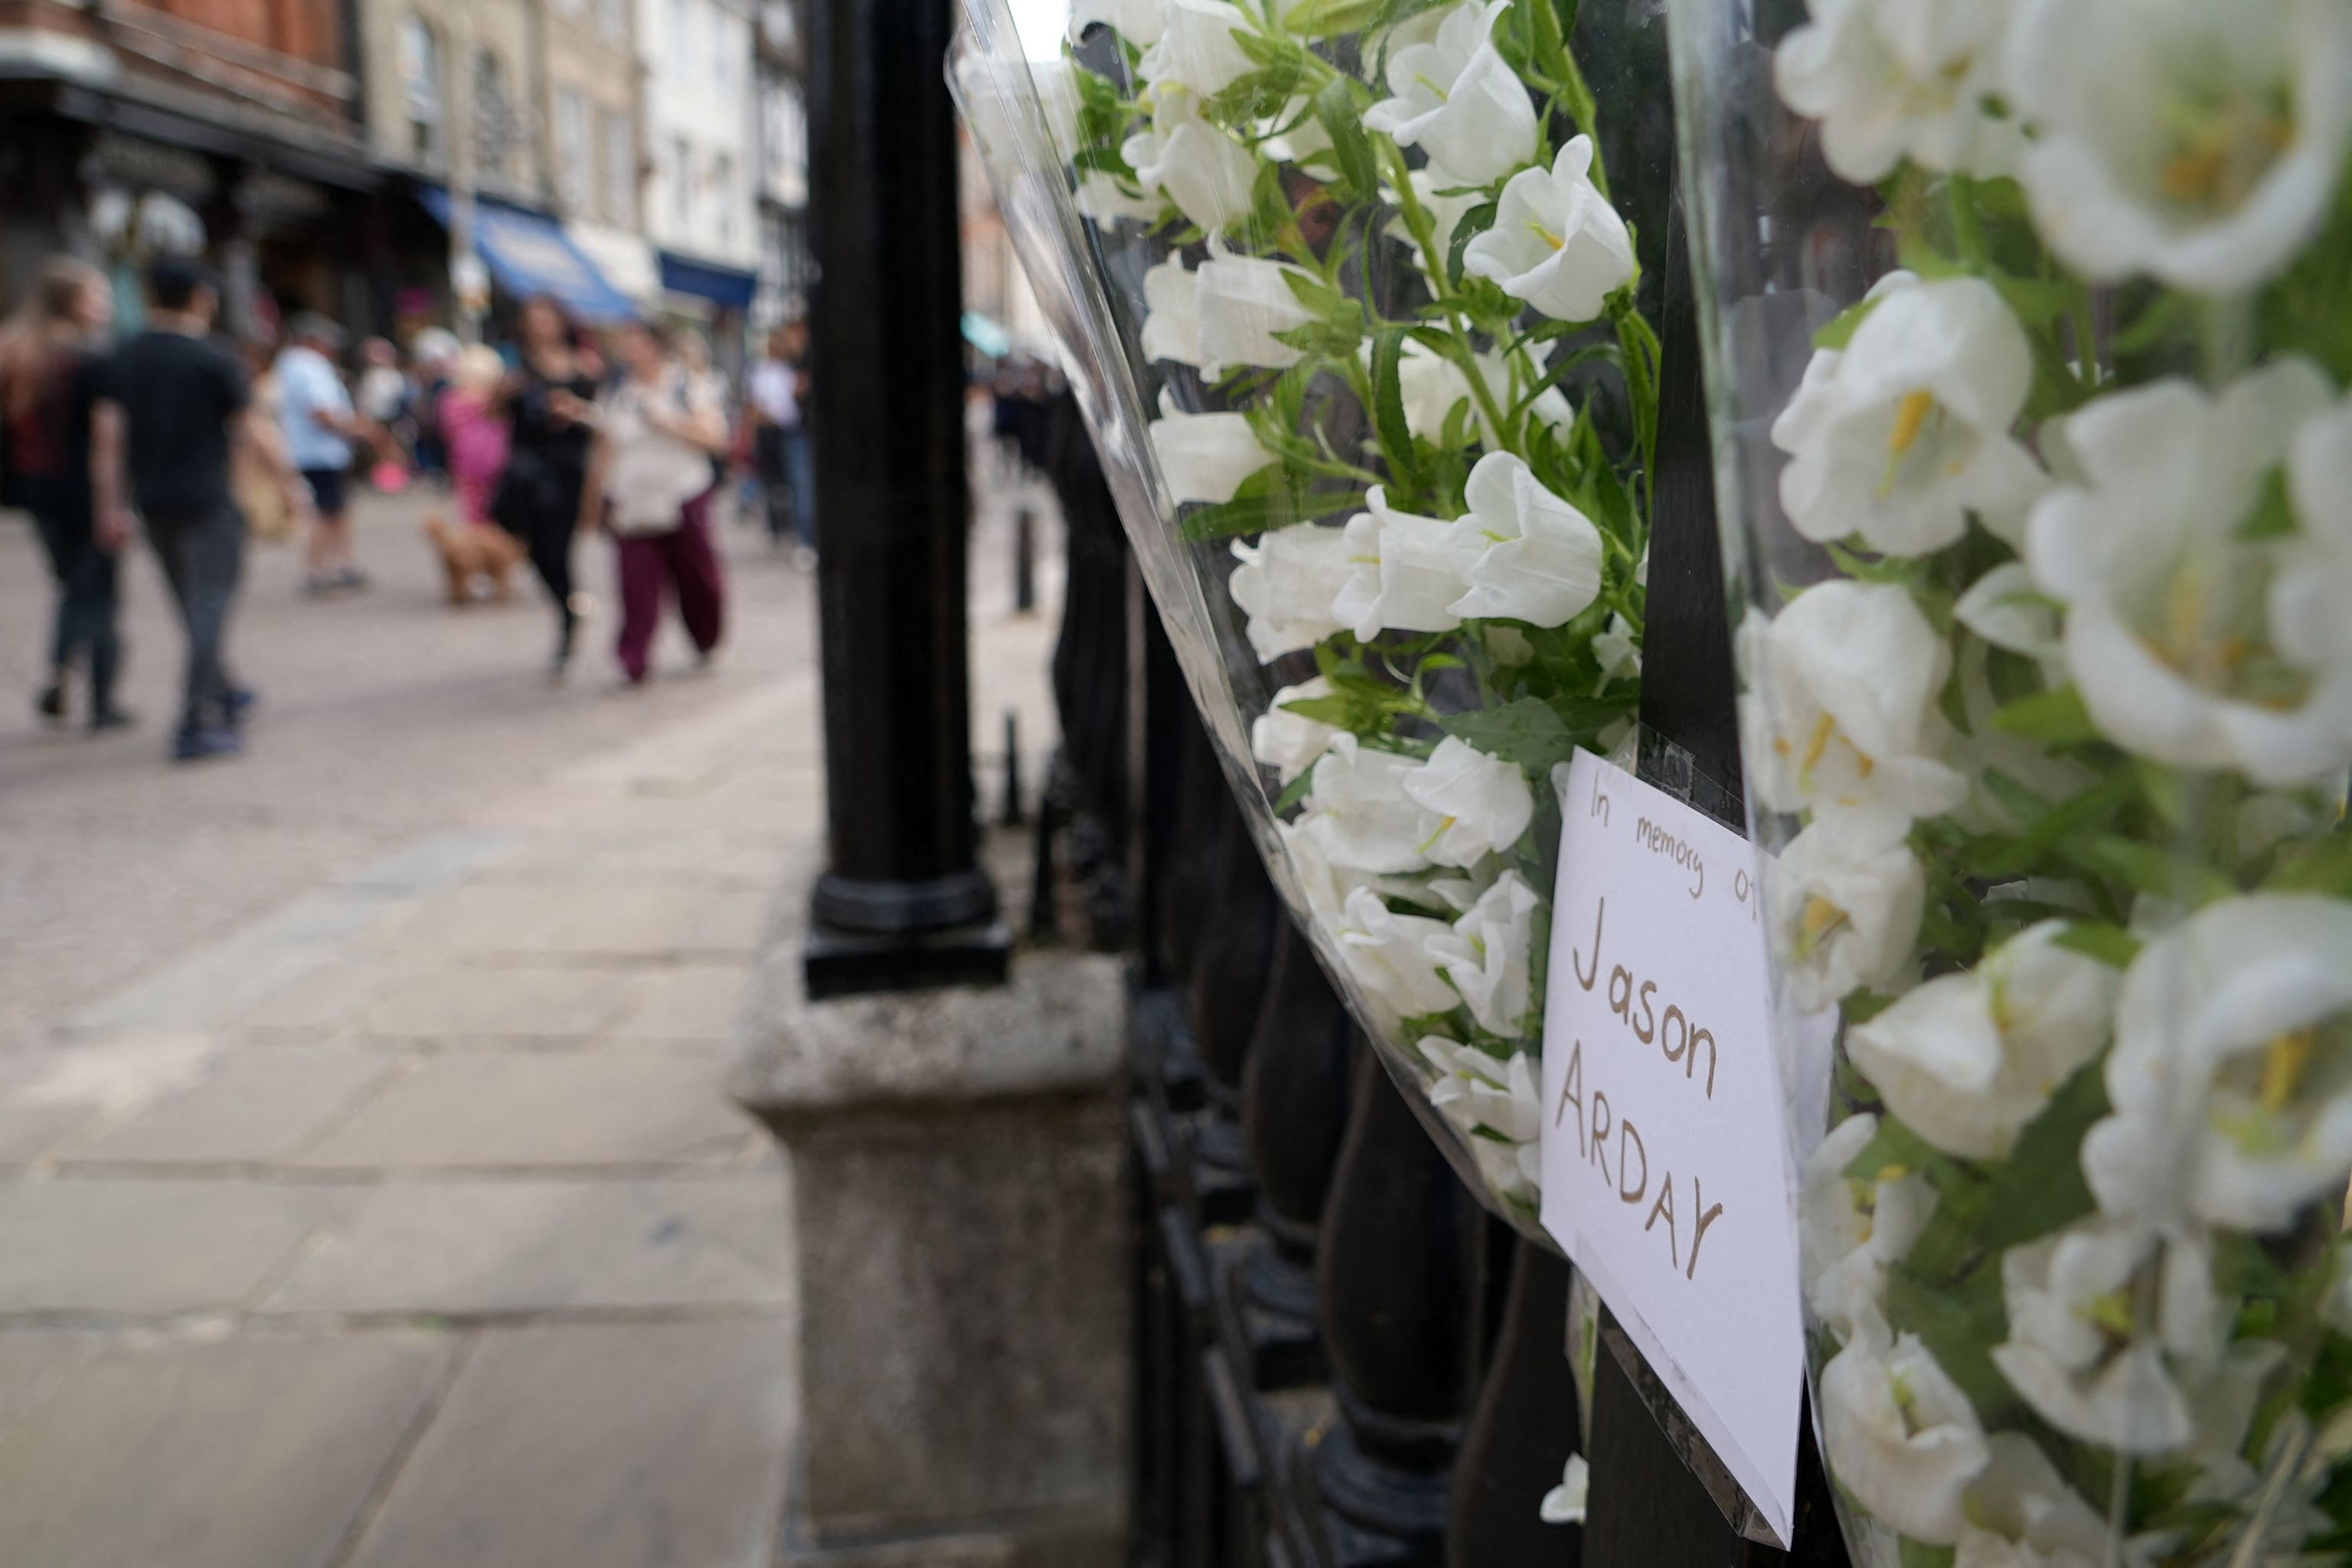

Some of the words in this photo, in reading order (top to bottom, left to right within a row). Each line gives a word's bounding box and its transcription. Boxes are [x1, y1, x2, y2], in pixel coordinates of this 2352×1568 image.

[1591, 769, 1609, 828] In
[1636, 816, 1704, 900] memory
[1573, 897, 1717, 1100] Jason
[1556, 1040, 1723, 1280] ARDAY
